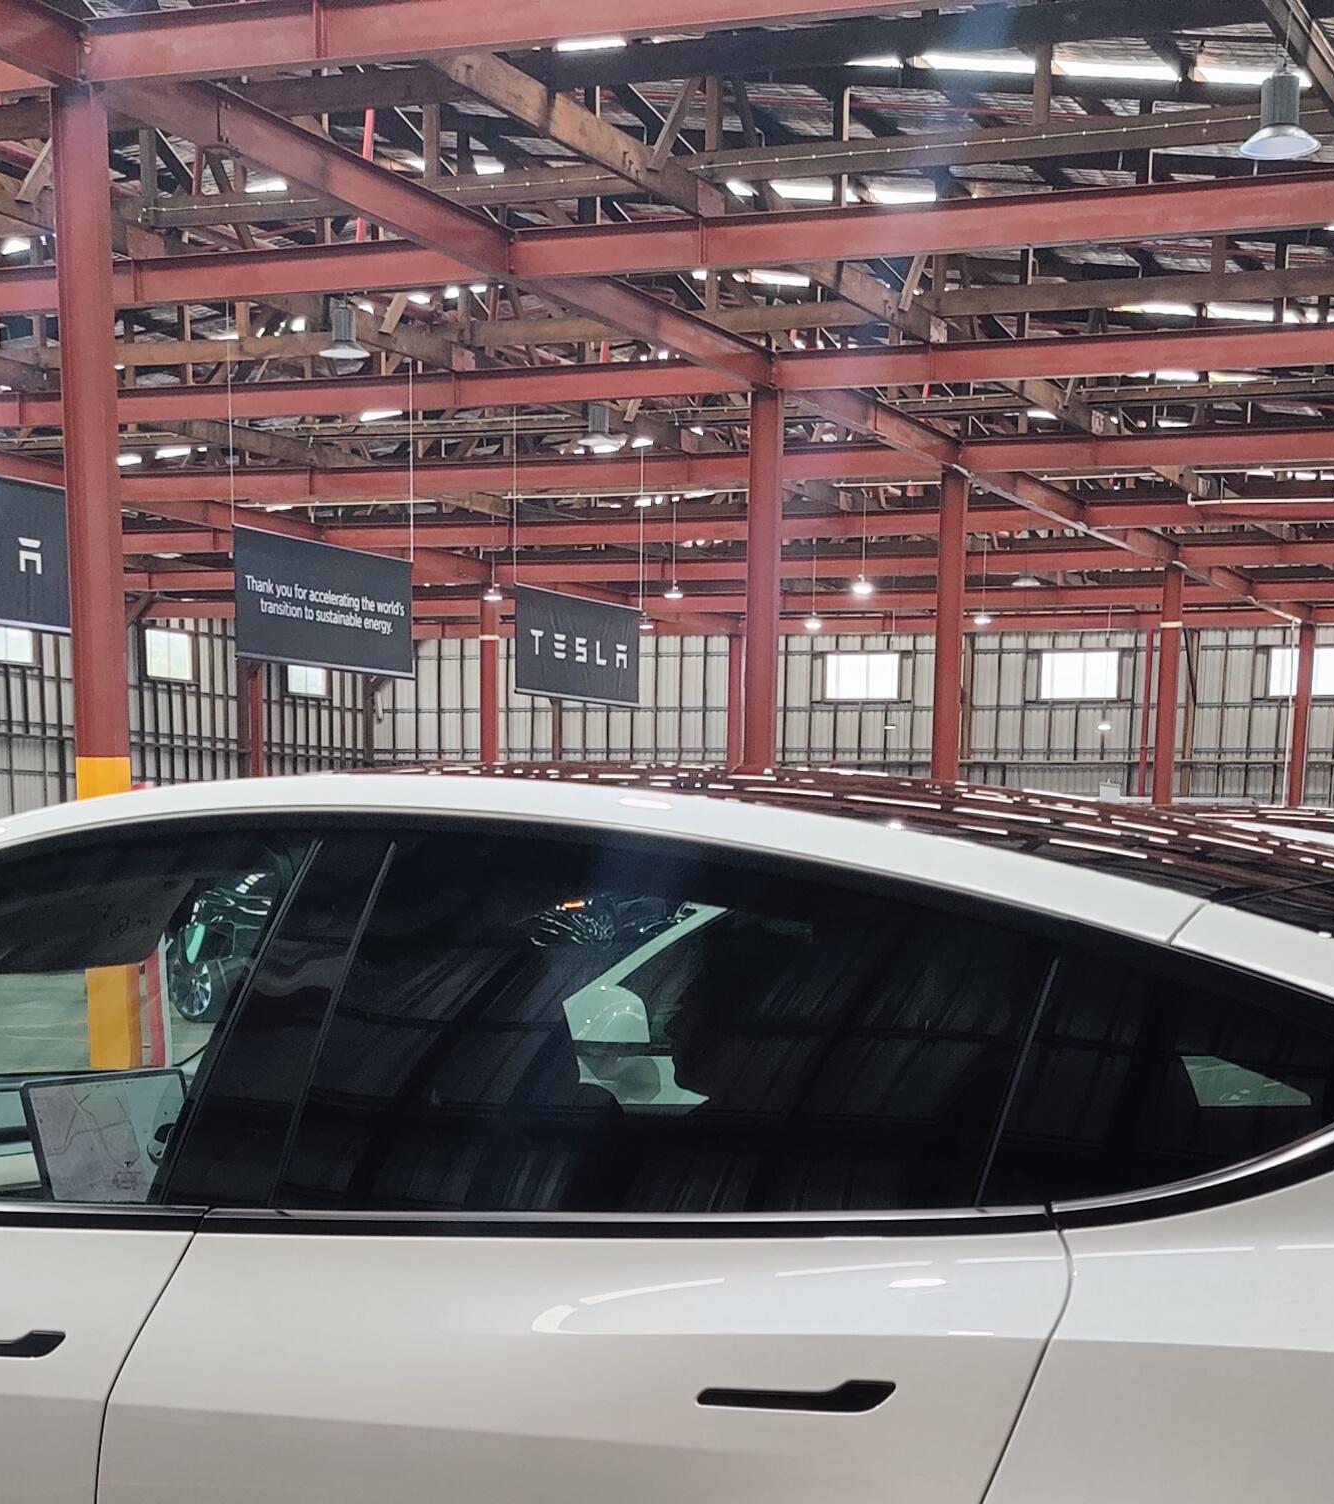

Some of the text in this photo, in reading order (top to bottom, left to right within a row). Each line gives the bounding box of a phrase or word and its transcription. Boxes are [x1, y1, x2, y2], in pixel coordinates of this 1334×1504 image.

[245, 575, 405, 616] Thank you for accelerating the world's
[260, 598, 393, 635] transition to sustainable energy.
[530, 629, 627, 669] TESLA
